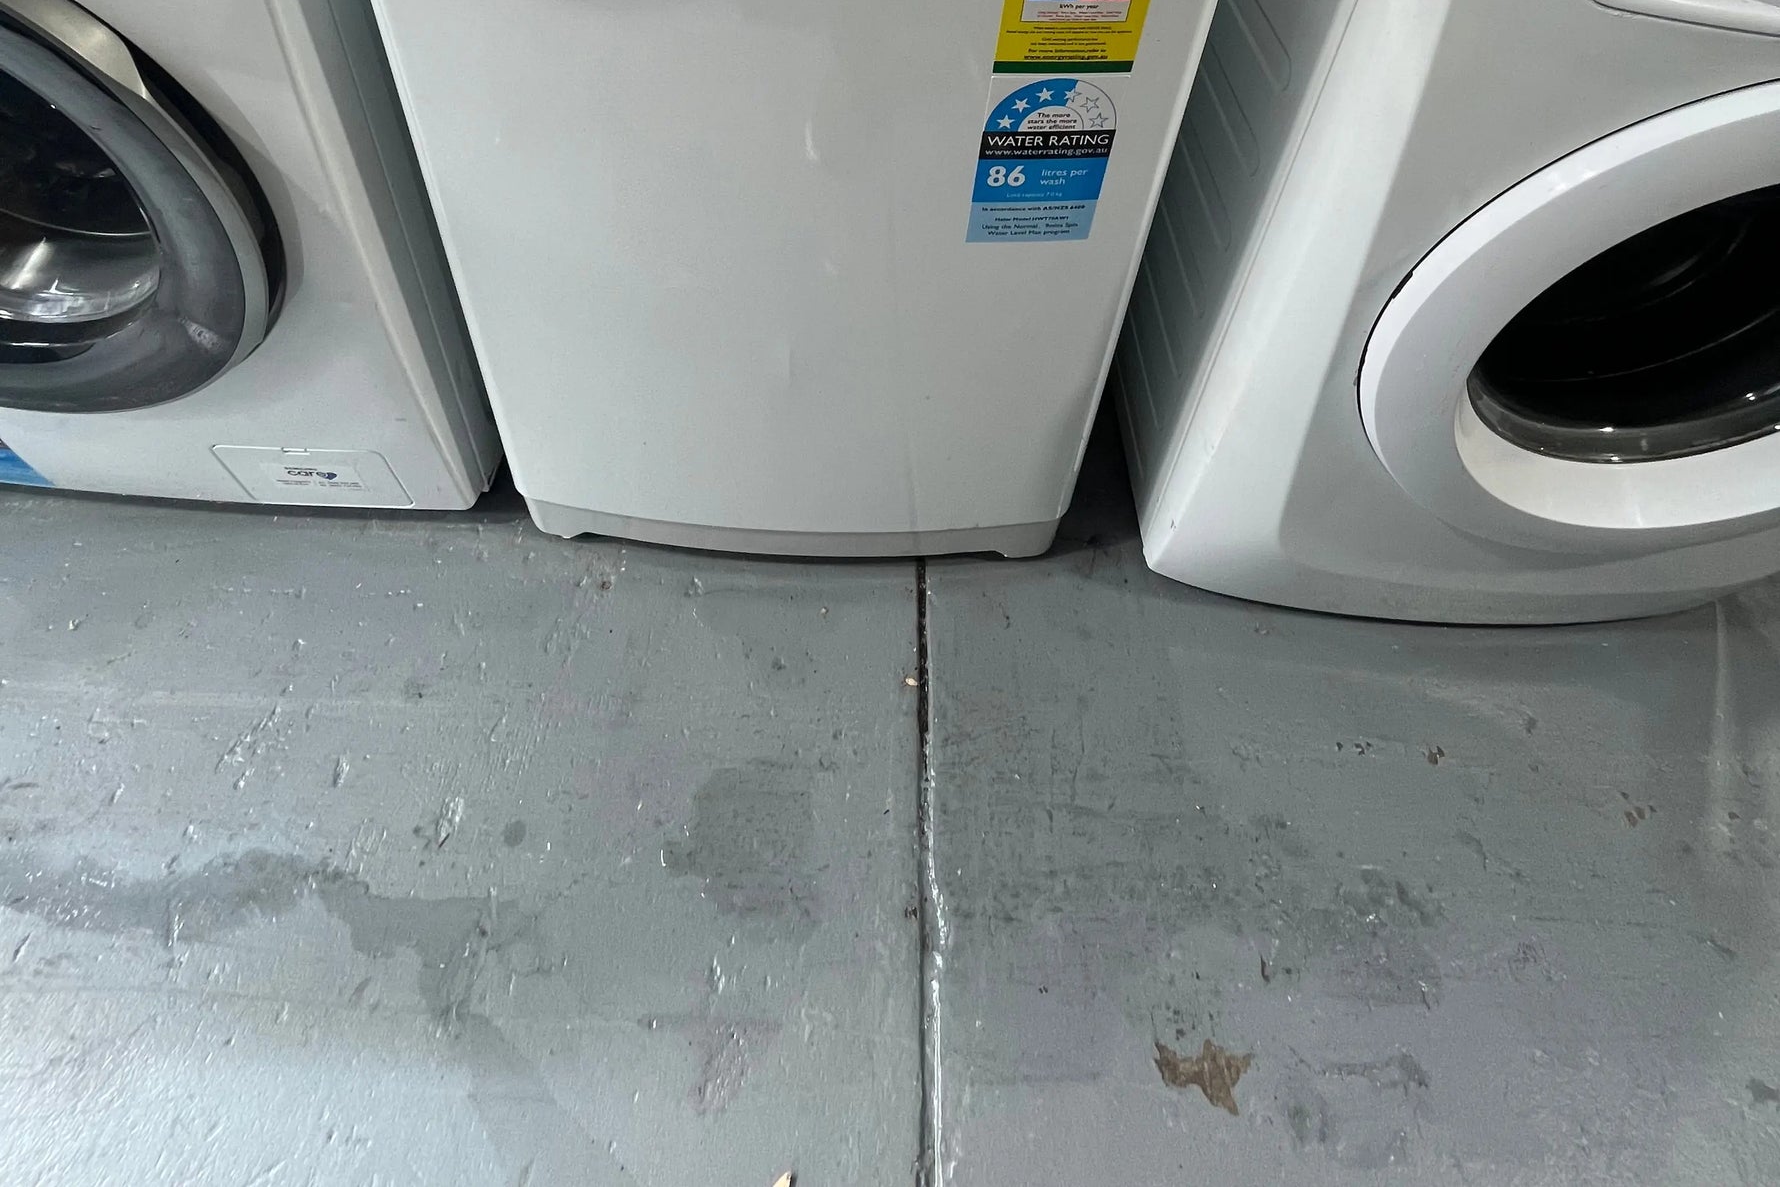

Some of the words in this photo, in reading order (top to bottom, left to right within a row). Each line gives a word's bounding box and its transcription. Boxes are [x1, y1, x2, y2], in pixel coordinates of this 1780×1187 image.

[987, 135, 1043, 147] WATER
[1049, 134, 1110, 146] RATING
[985, 148, 1108, 156] www.waterrating.gov.au
[987, 166, 1026, 187] 86
[1041, 169, 1067, 177] litres
[1070, 169, 1088, 178] per
[1040, 177, 1066, 185] wash
[1043, 228, 1070, 236] program
